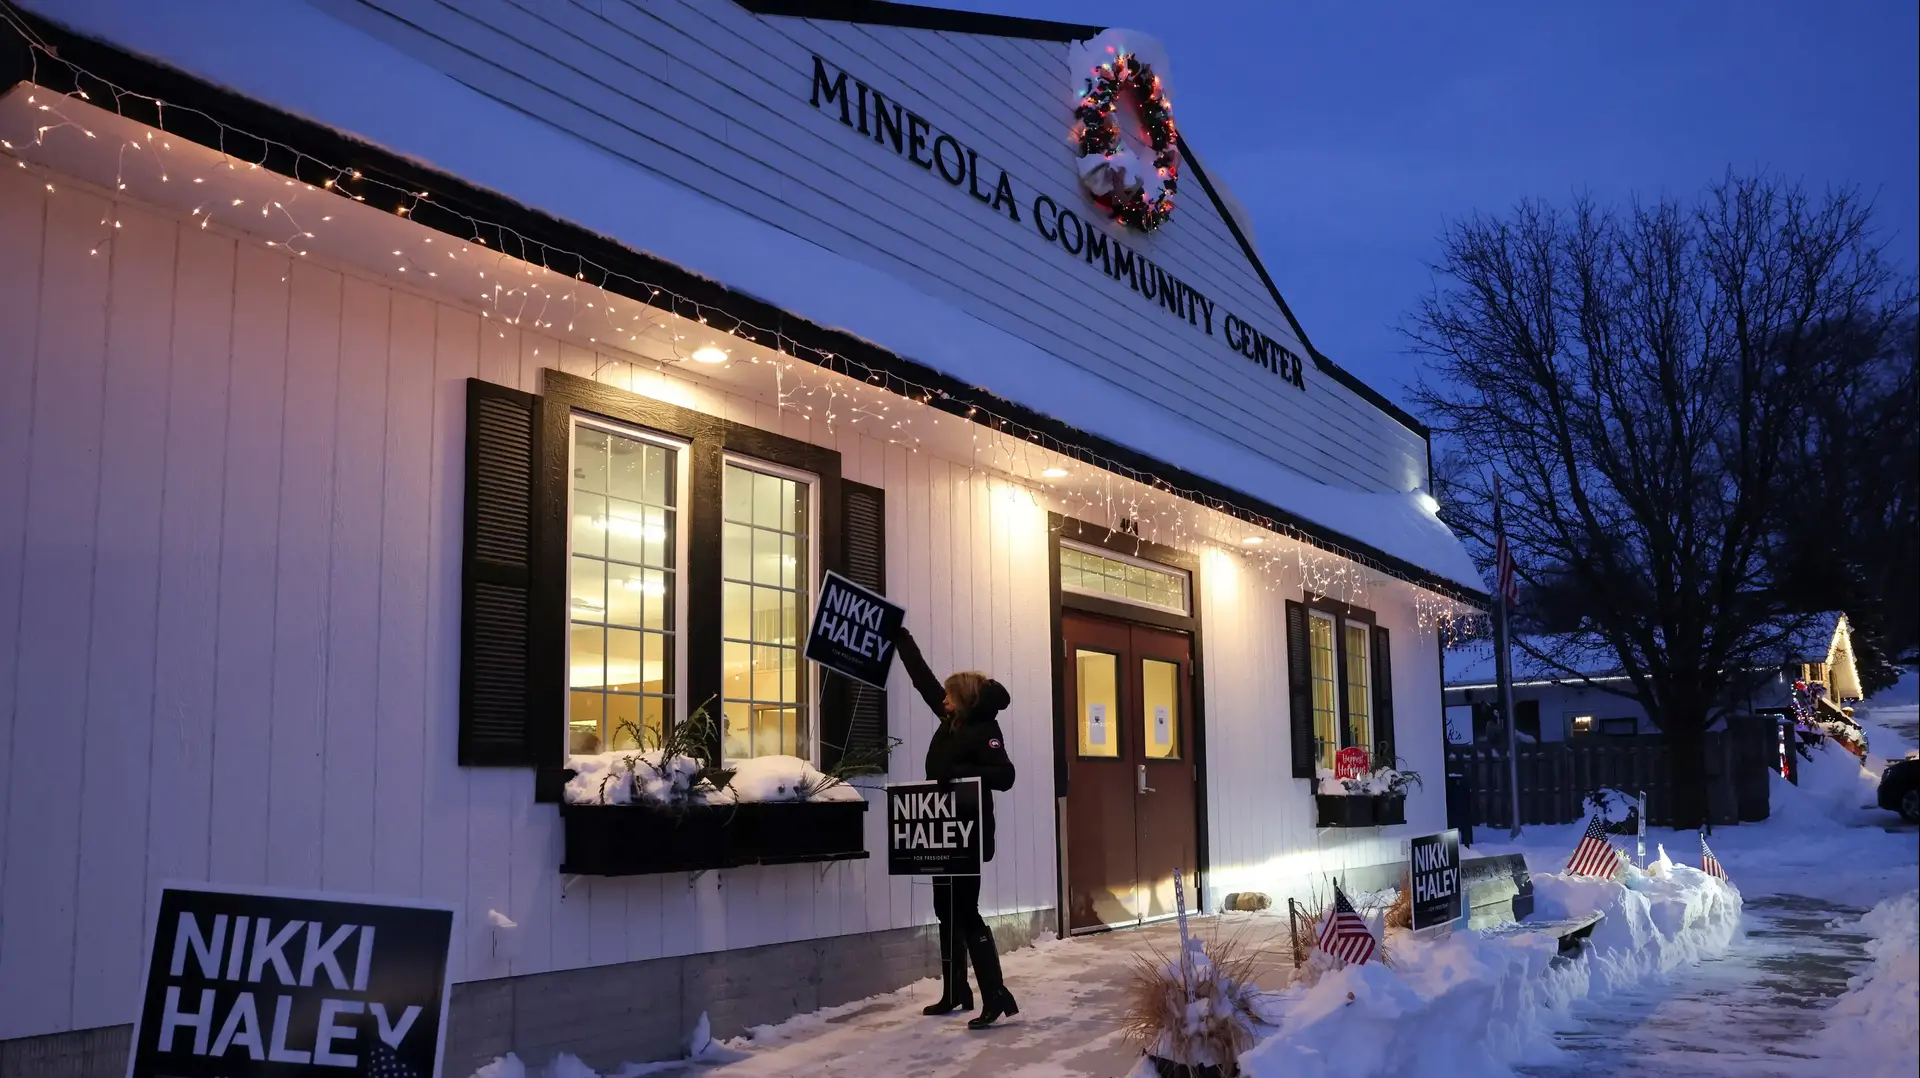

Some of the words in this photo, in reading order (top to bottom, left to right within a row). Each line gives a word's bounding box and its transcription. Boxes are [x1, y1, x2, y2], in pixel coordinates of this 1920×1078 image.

[809, 55, 1021, 223] MINEOLA
[1033, 195, 1215, 335] COMMUNITY
[1224, 312, 1306, 391] CENTER
[825, 584, 885, 631] NIKKI
[817, 611, 892, 662] HALEY
[893, 791, 957, 821] NIKKI
[894, 820, 974, 850] HALEY
[1415, 842, 1450, 874] NIKKI
[1415, 867, 1458, 904] HALEY
[169, 911, 376, 992] NIKKI
[157, 985, 423, 1068] HALEY
